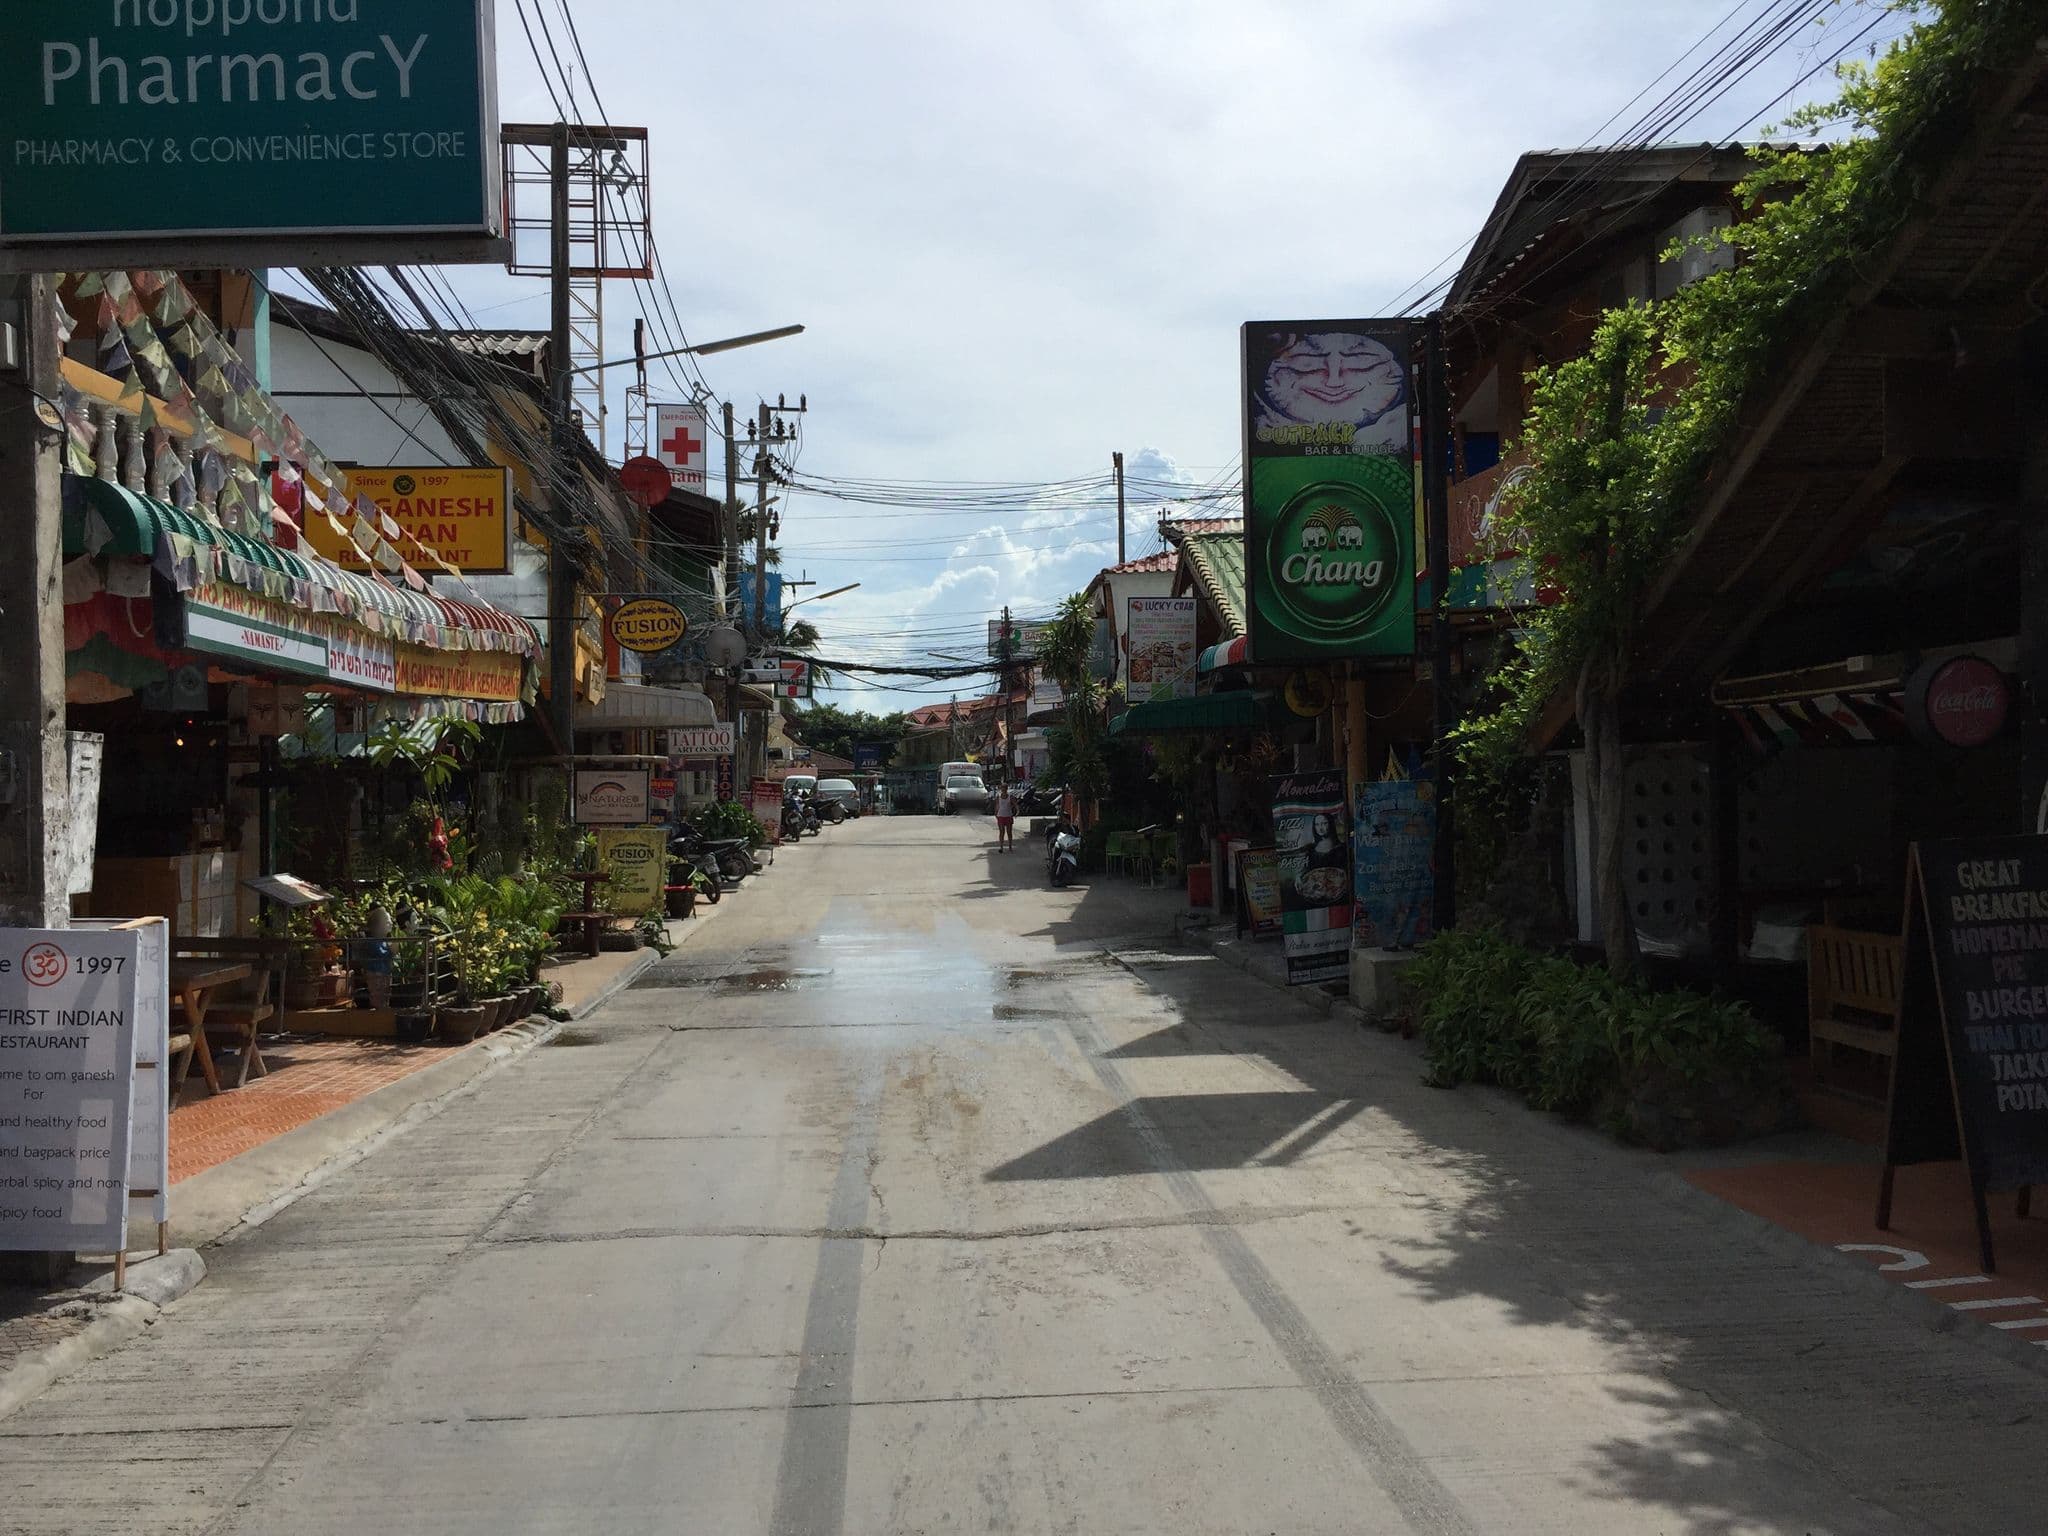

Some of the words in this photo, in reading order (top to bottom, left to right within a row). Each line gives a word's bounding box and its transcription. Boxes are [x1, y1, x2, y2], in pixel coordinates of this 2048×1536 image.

[14, 138, 155, 166] PHARMACY
[161, 137, 182, 163] &
[190, 133, 376, 163] CONVENIENCE
[383, 131, 465, 160] STORE
[1305, 446, 1329, 456] BAR
[1332, 446, 1344, 455] &
[1345, 445, 1396, 455] LOUNGE
[354, 475, 387, 486] Since
[421, 476, 450, 486] 1997
[1281, 553, 1384, 587] Chang
[1145, 601, 1171, 611] LUCKY
[1173, 601, 1194, 611] CRAB
[614, 617, 682, 635] FUSION
[672, 732, 730, 746] TATTOO
[609, 848, 655, 858] FUSION
[1956, 859, 2022, 890] GREAT
[75, 956, 126, 974] 1997
[57, 1009, 124, 1027] INDIAN
[0, 1036, 90, 1049] ESTAURANT
[28, 1070, 41, 1080] to
[46, 1071, 66, 1081] om
[71, 1069, 115, 1084] ganesh
[23, 1088, 45, 1100] For
[25, 1116, 73, 1130] healthy
[77, 1116, 107, 1128] food
[24, 1147, 76, 1160] bagpack
[79, 1147, 111, 1162] price
[33, 1178, 63, 1190] spicy
[67, 1177, 93, 1189] and
[97, 1180, 122, 1189] non
[32, 1206, 63, 1218] food
